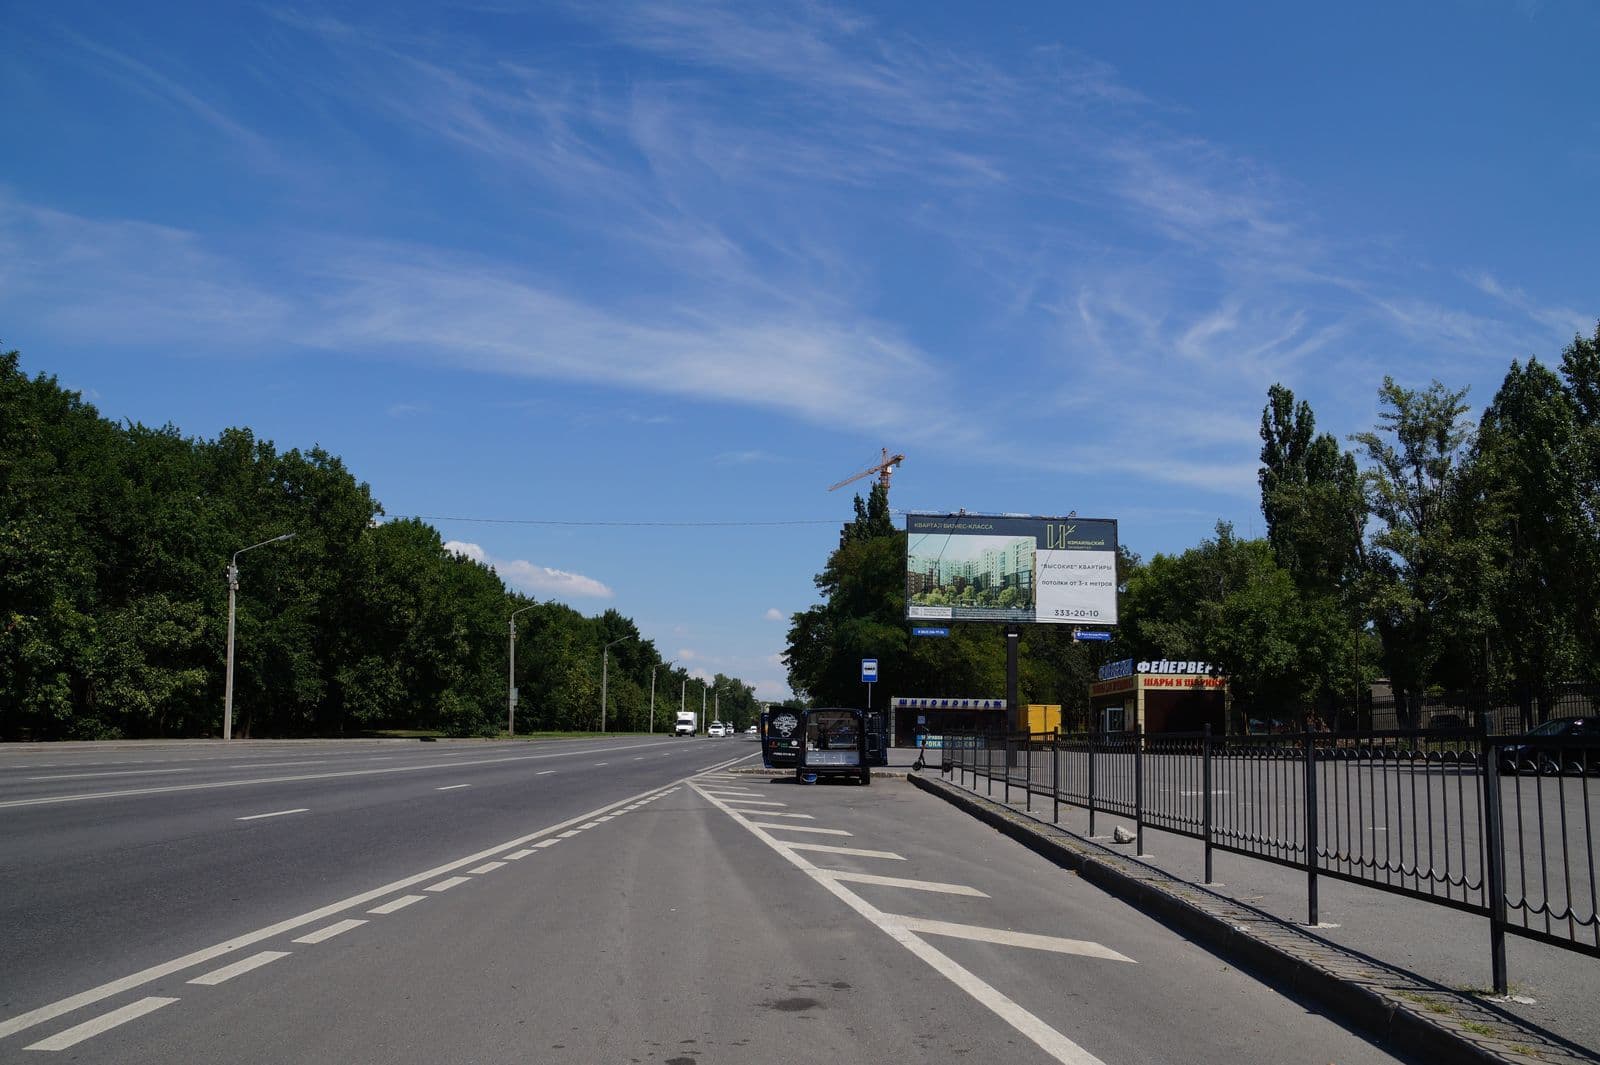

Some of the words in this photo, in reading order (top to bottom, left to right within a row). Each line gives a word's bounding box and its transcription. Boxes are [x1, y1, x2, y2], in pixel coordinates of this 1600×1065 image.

[1054, 609, 1100, 617] 333-20-10
[1137, 658, 1223, 675] ФЕЙЕРВЕР
[1143, 678, 1174, 687] ШАРЫ
[899, 699, 1002, 709] ШИНОМОНТАЖ
